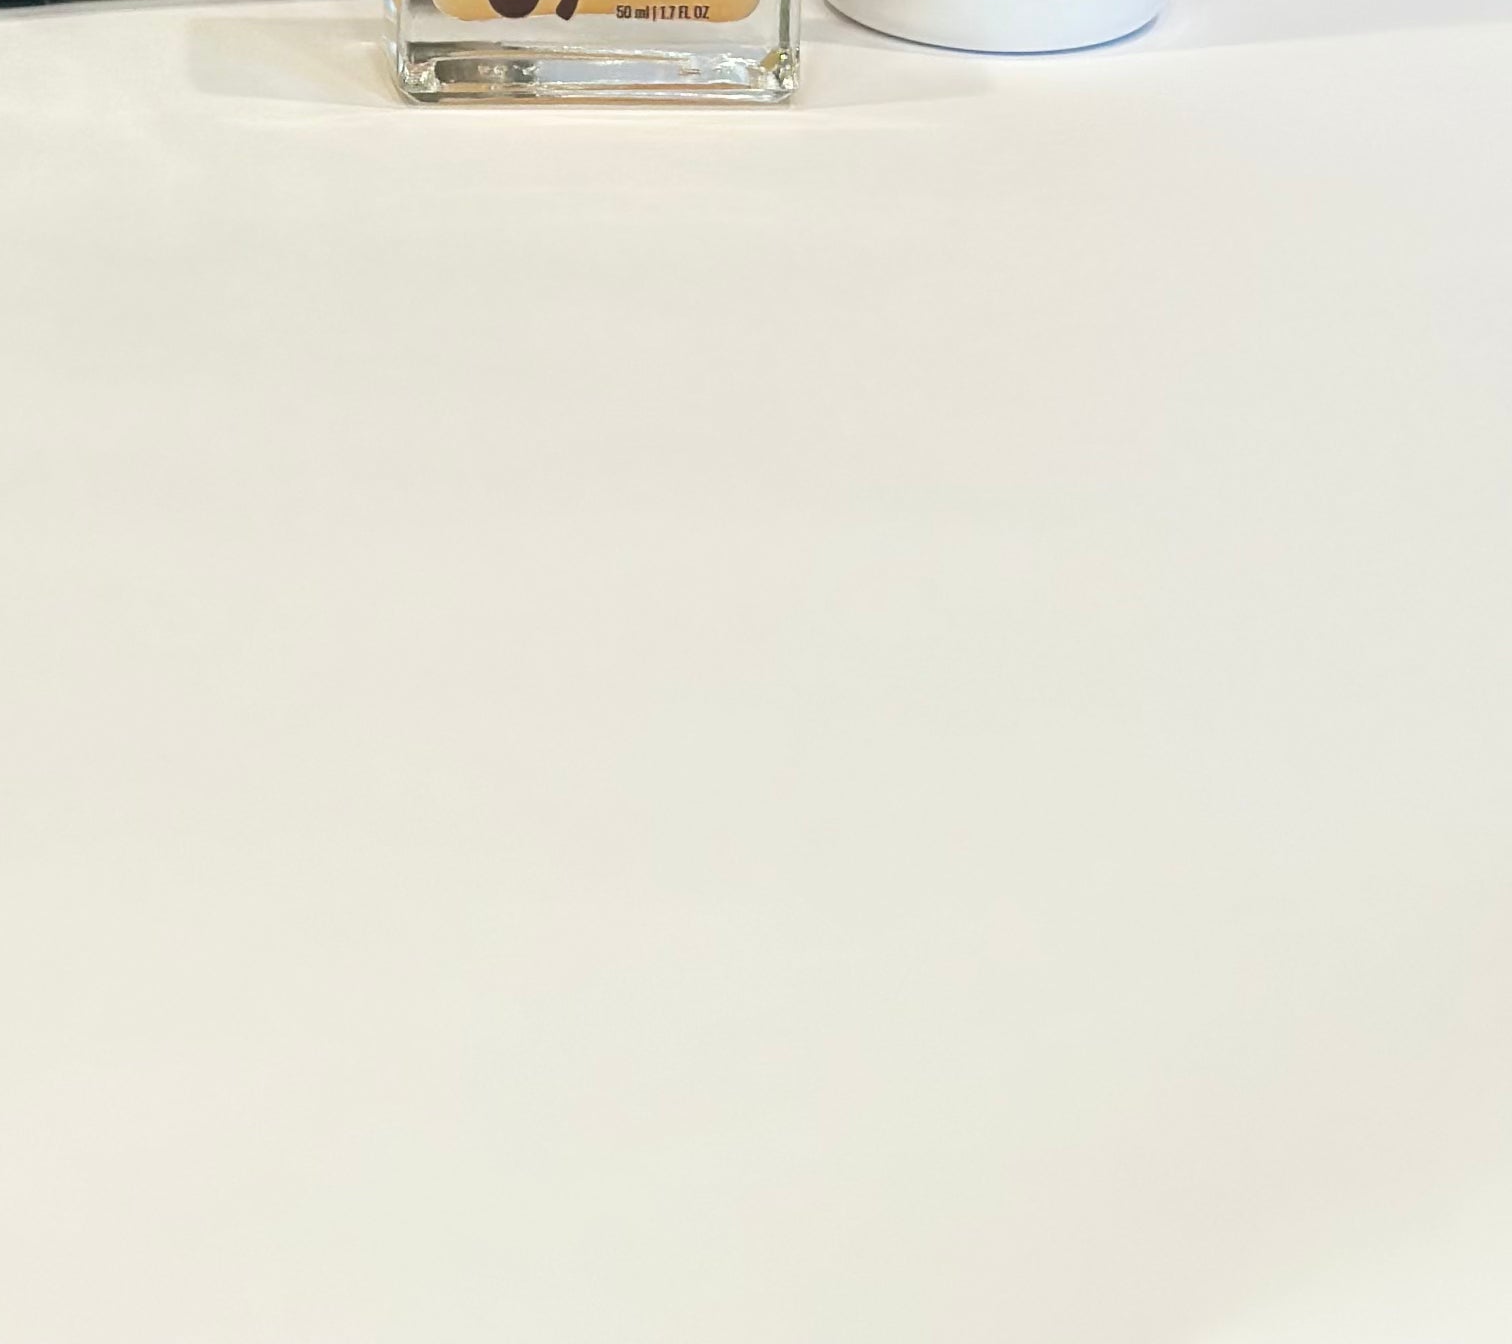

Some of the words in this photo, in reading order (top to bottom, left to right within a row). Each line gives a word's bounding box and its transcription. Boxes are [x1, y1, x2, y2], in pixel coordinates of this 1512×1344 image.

[616, 5, 632, 19] 50
[634, 5, 650, 19] ml
[694, 6, 710, 20] OZ
